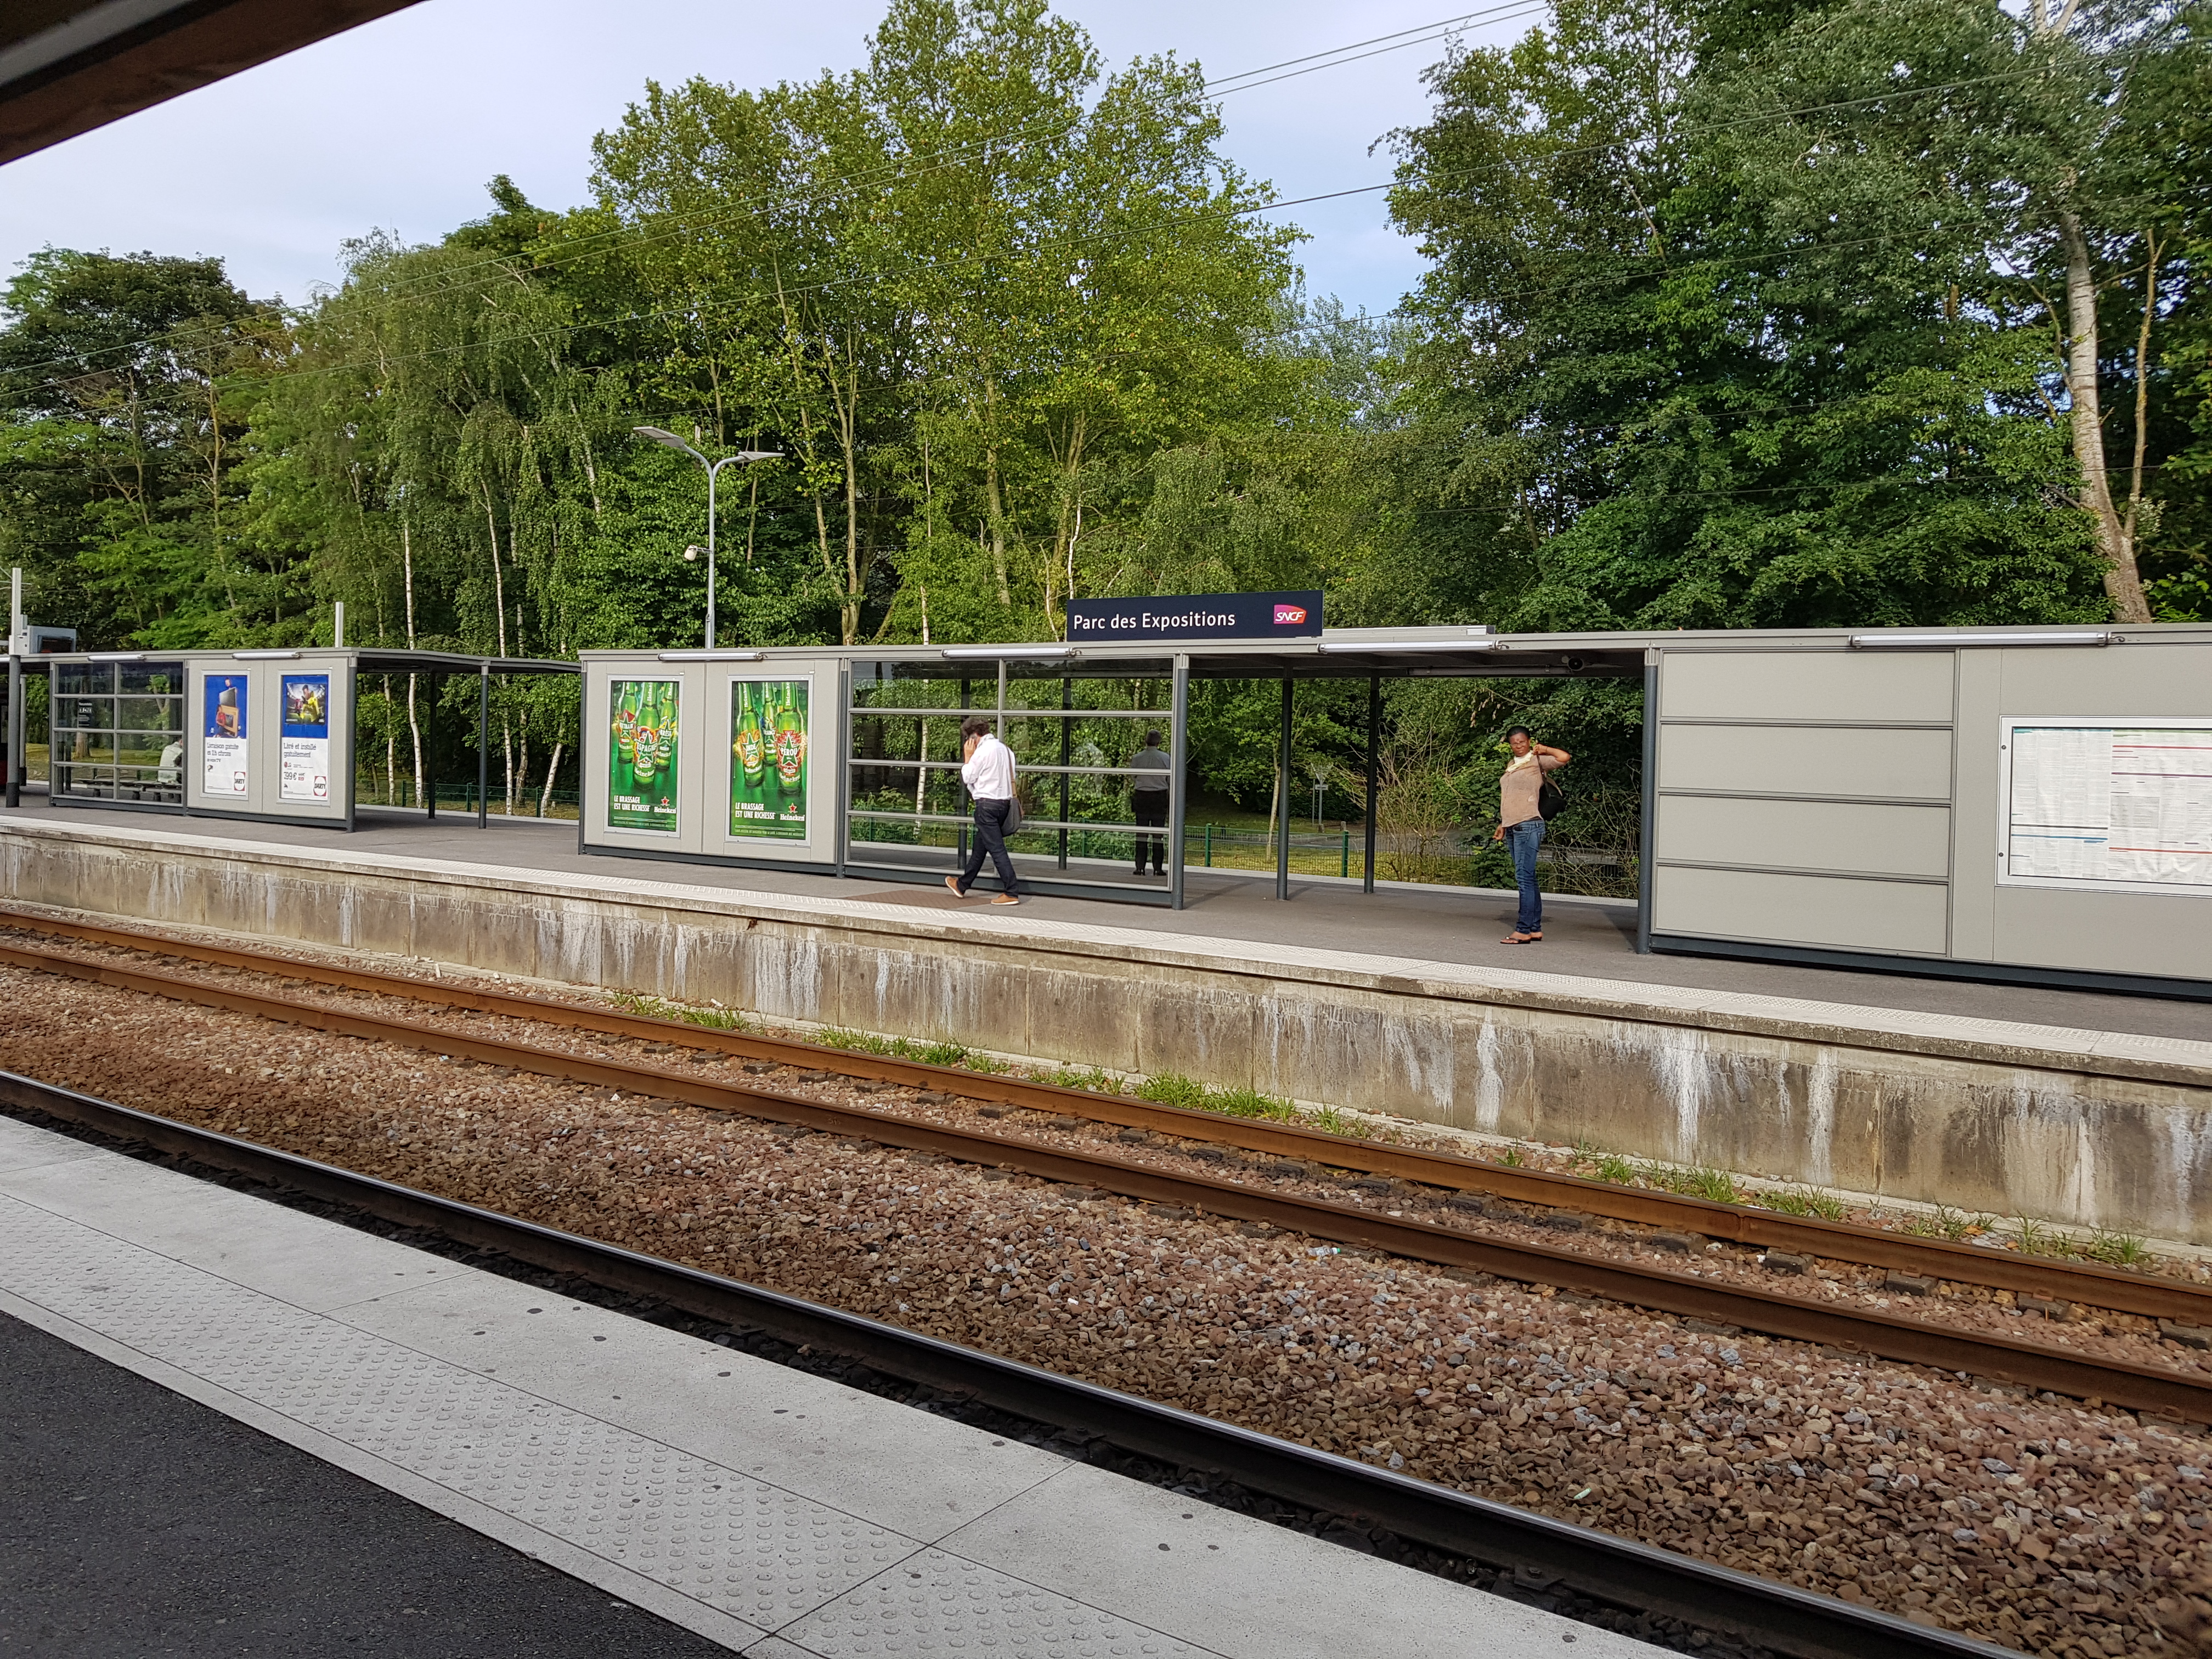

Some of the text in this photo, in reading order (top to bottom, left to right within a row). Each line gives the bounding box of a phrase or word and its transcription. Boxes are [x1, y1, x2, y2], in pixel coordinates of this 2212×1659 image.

[1074, 611, 1235, 631] Parc des Expositions
[1275, 611, 1305, 622] SNCF
[619, 795, 640, 804] BRASSAGE
[741, 803, 764, 811] BRASSAGE
[754, 811, 775, 820] RICHESSE
